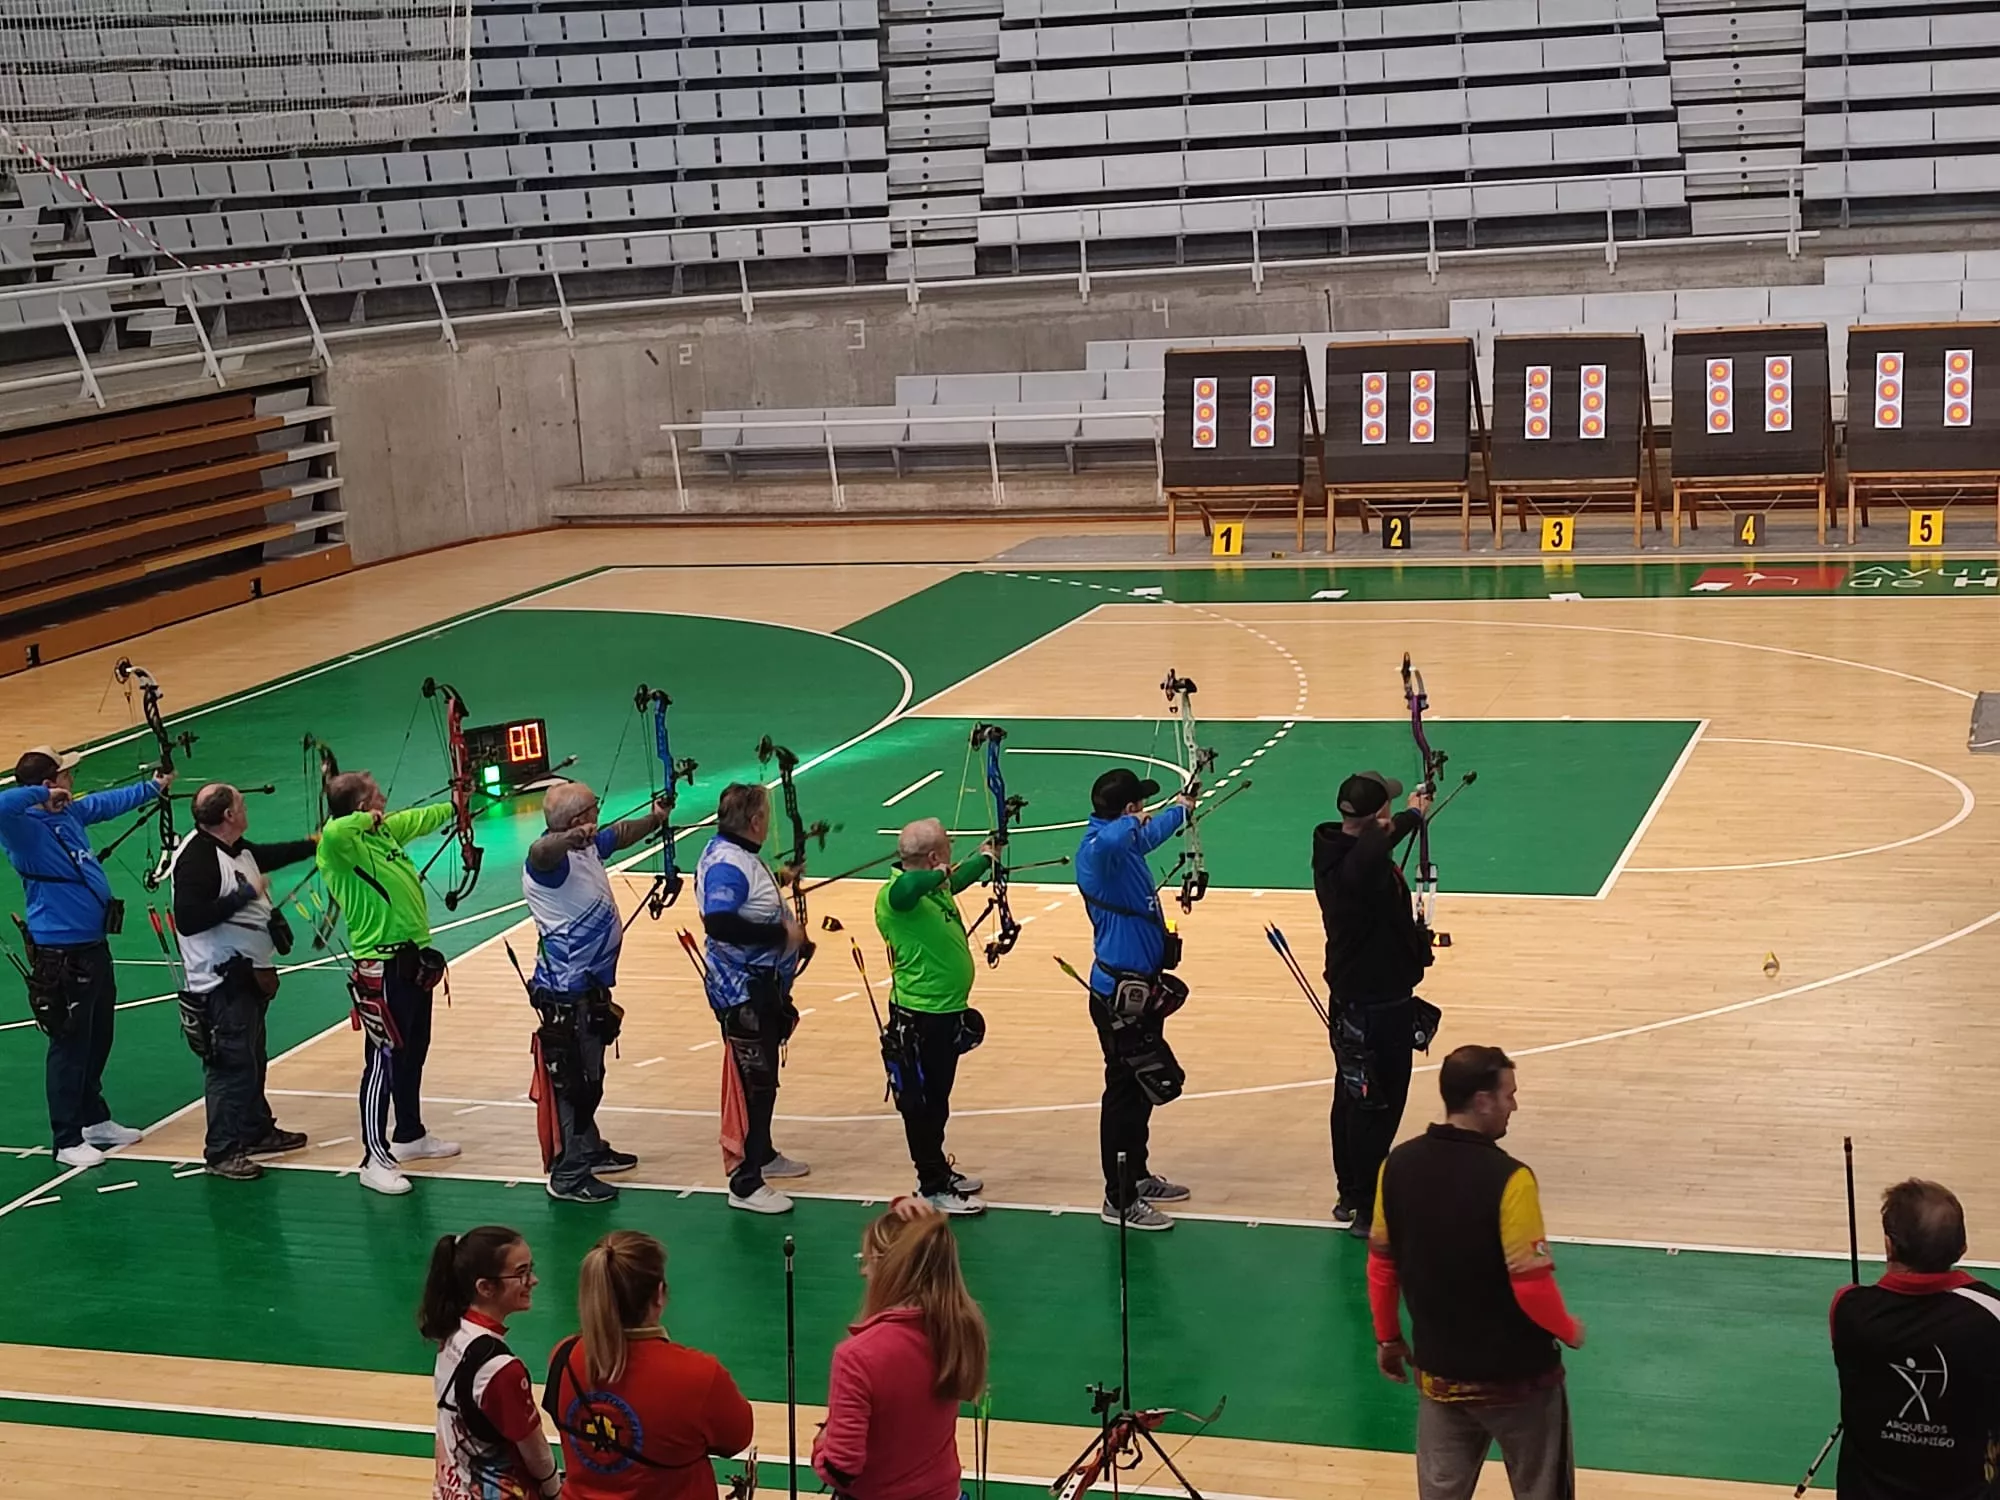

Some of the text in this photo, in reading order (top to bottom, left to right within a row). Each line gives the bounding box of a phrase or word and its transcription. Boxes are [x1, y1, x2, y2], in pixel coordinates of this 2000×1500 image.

[1152, 298, 1169, 328] 4
[845, 319, 865, 349] 3
[679, 343, 692, 365] 2
[1220, 527, 1232, 552] 1
[1390, 518, 1402, 547] 2
[1551, 521, 1563, 547] 3
[1741, 515, 1755, 545] 4
[1920, 514, 1932, 542] 5
[508, 722, 542, 763] 80
[1886, 1419, 1948, 1435] ARQUEROS
